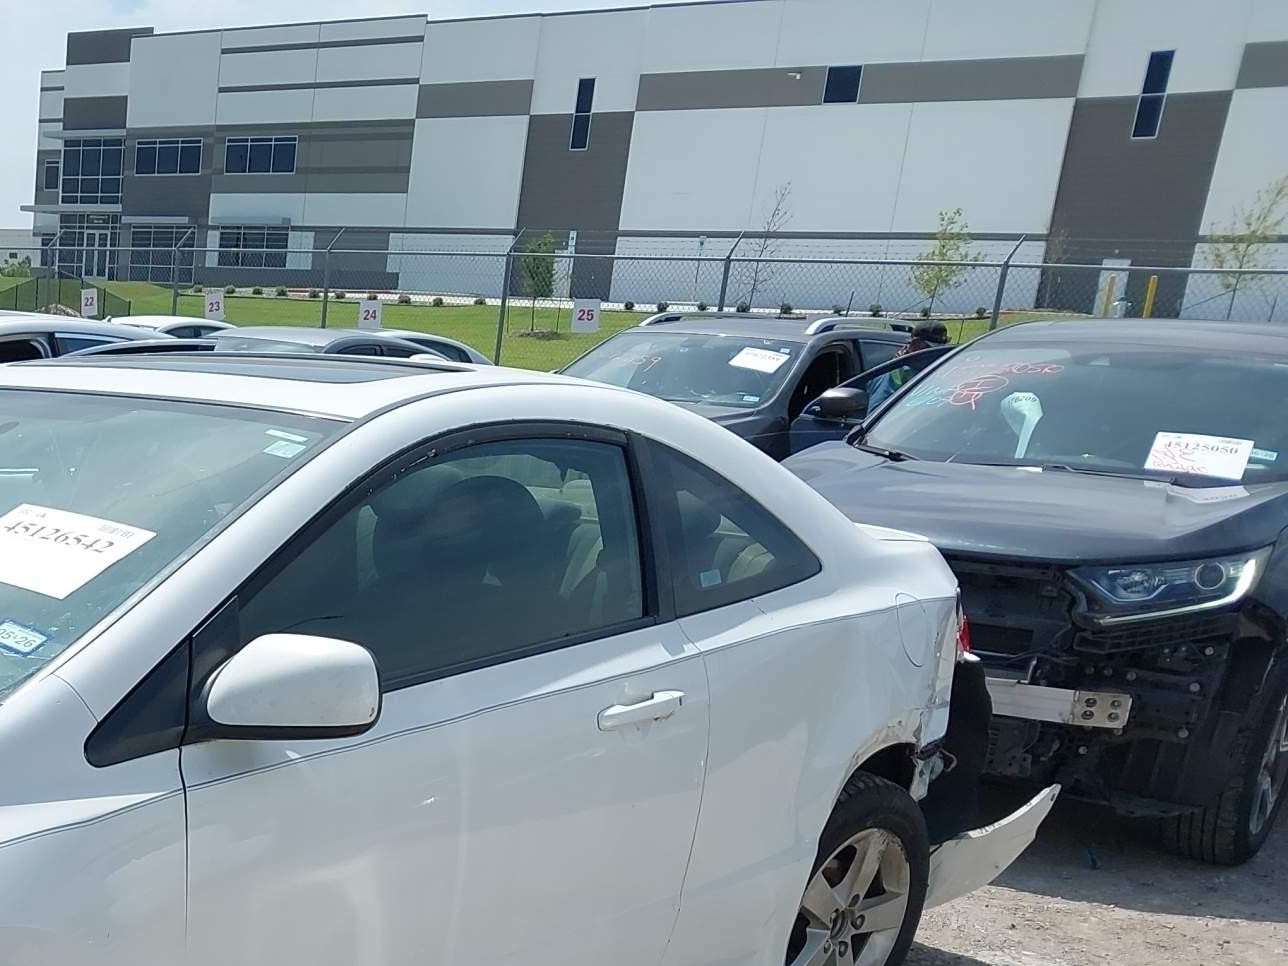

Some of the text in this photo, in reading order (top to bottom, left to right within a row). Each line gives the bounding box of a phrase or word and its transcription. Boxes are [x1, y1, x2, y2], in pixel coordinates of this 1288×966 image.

[83, 296, 95, 306] 22
[208, 301, 220, 312] 23
[362, 309, 377, 321] 24
[577, 308, 595, 321] 25
[3, 520, 115, 554] 45126542
